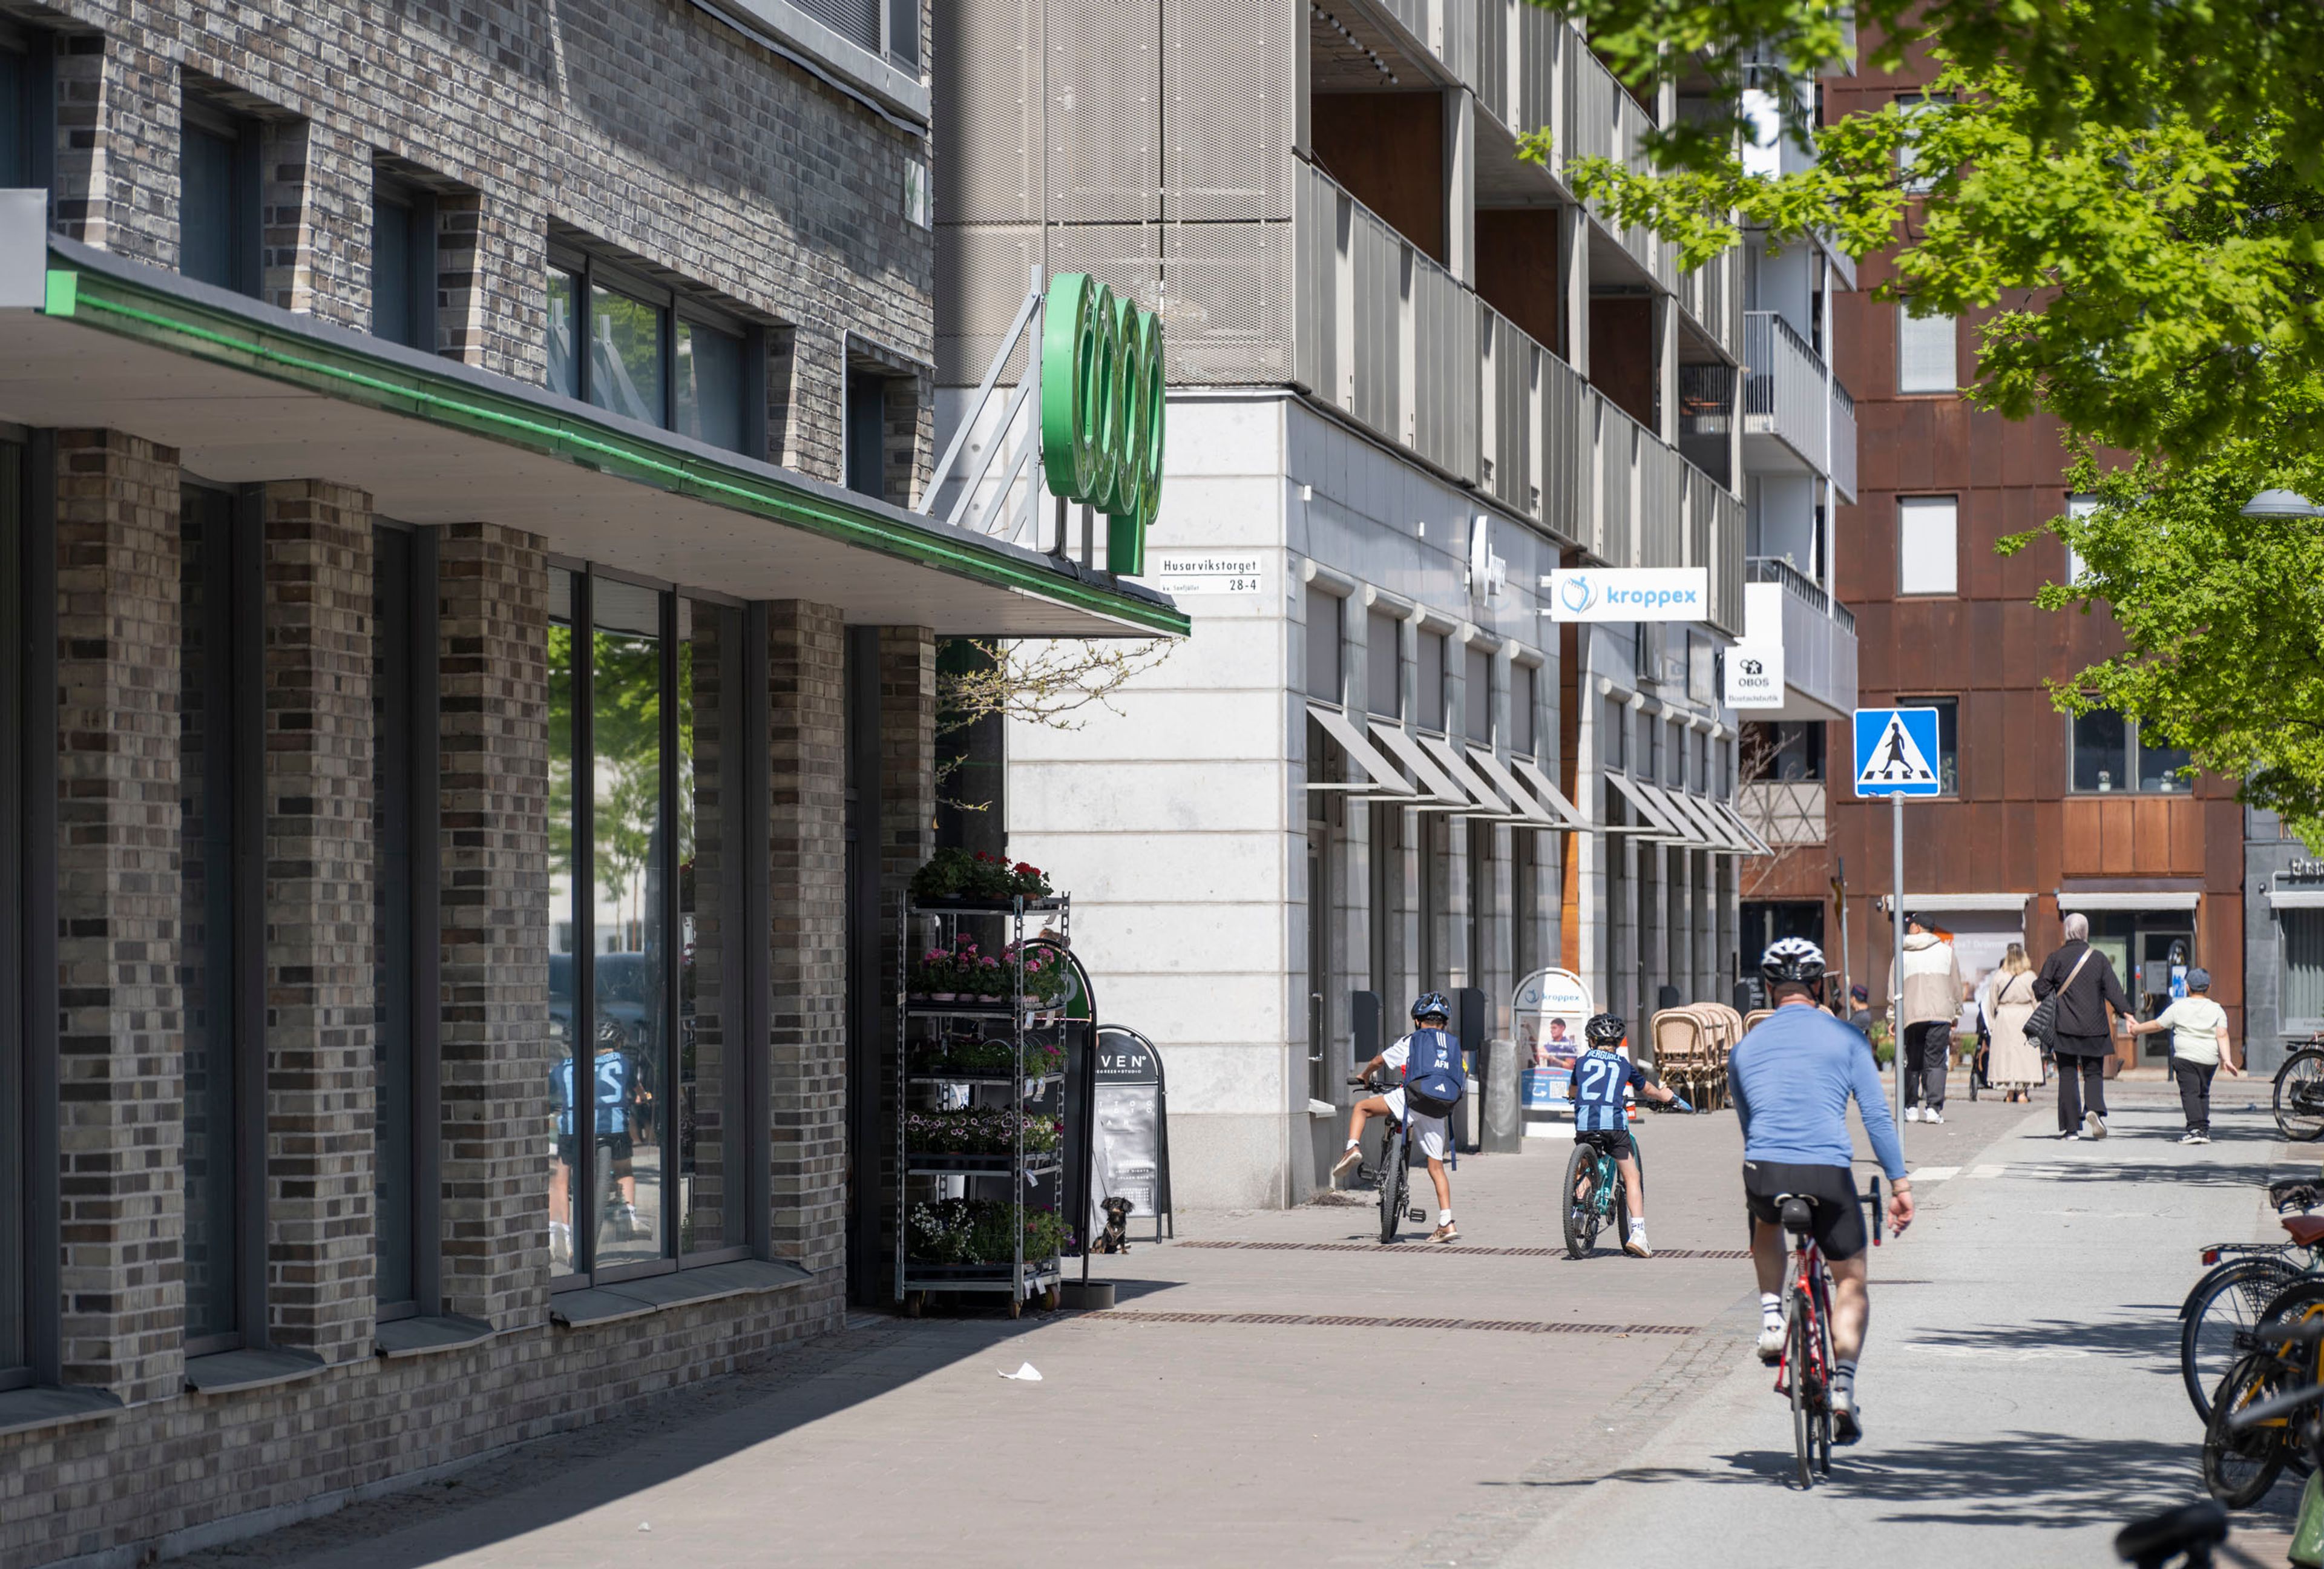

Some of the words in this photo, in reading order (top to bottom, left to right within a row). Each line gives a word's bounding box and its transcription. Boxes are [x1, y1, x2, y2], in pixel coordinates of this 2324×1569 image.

[1164, 559, 1256, 573] Husarvikstorget
[1230, 579, 1256, 591] 28-4
[1607, 585, 1696, 608] kroppex
[1738, 677, 1769, 687] OBOS
[1541, 992, 1579, 1002] kroppex
[1581, 1059, 1620, 1103] 21
